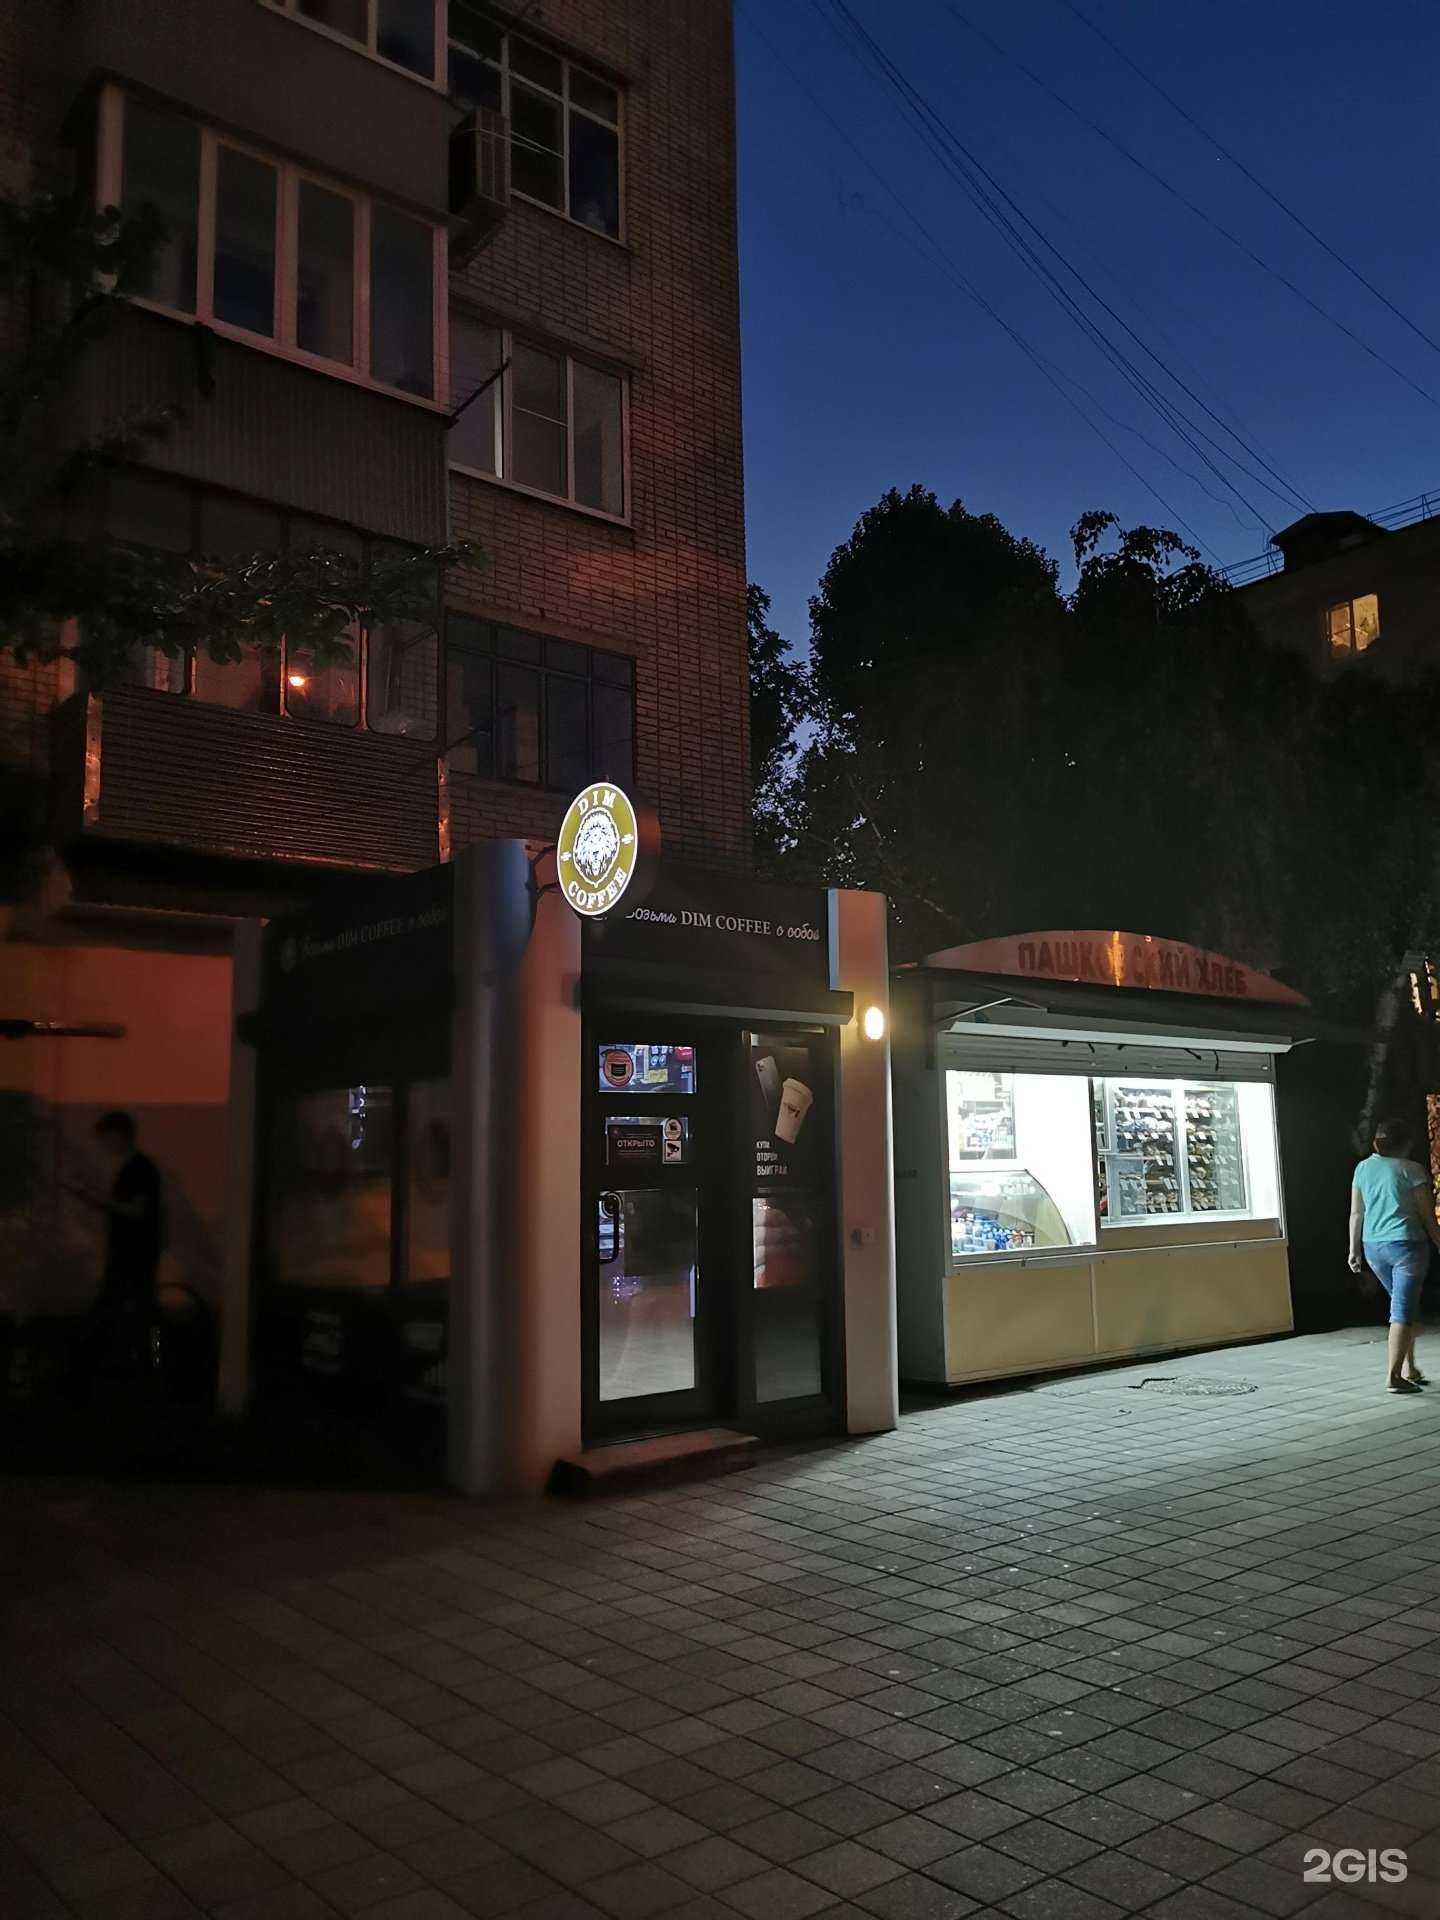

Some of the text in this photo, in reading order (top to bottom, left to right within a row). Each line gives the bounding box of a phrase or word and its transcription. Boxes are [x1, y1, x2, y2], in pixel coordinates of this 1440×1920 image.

[578, 790, 616, 815] DIM
[568, 867, 627, 908] COFFEE
[625, 908, 677, 923] озьми
[681, 910, 711, 928] DIM
[715, 915, 771, 935] COFFEE
[1197, 957, 1248, 994] ХЛЕБ
[616, 1138, 656, 1149] ОТКРЫТО
